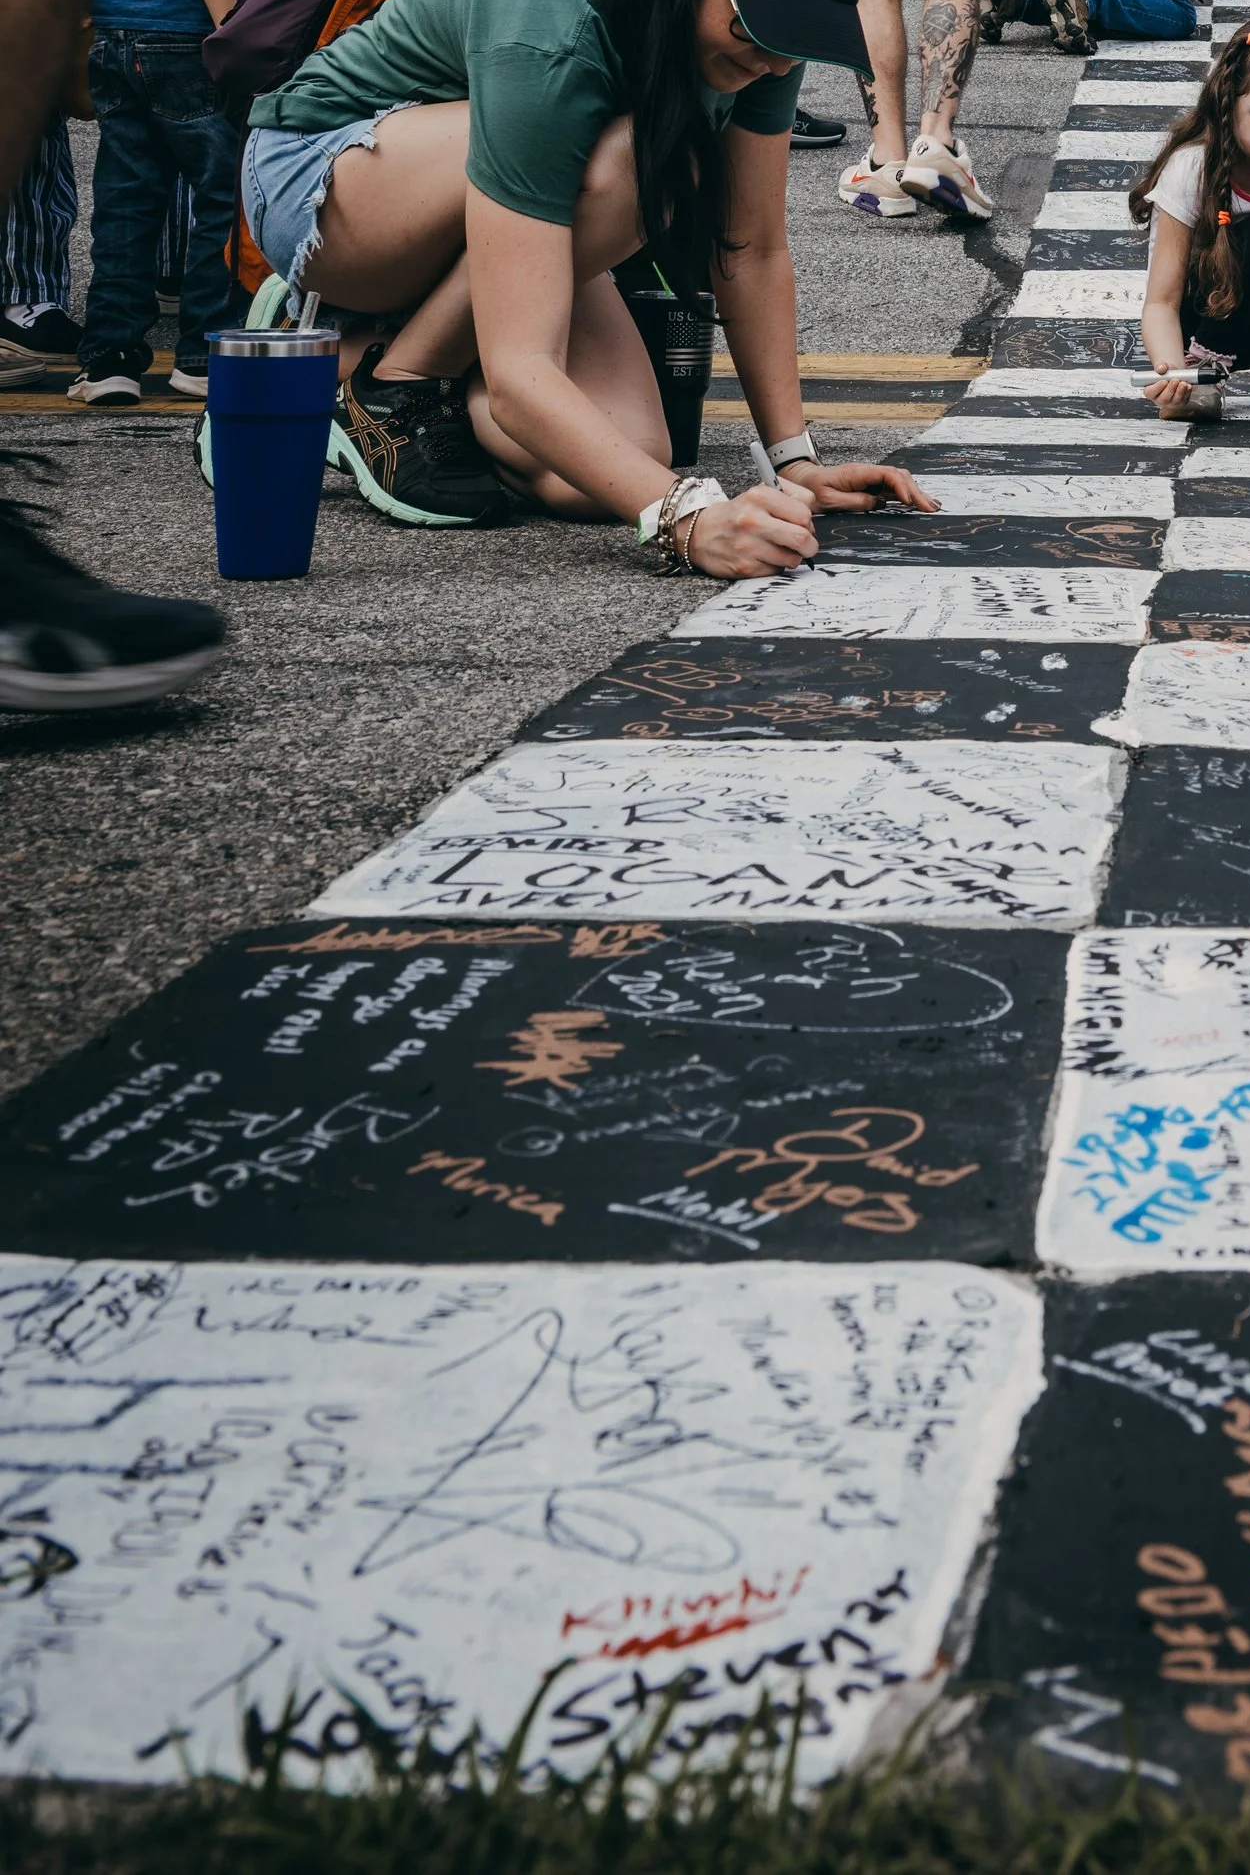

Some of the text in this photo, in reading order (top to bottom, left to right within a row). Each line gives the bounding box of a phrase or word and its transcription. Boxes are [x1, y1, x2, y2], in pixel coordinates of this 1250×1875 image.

[668, 311, 684, 321] US
[672, 366, 695, 377] EST
[429, 847, 901, 890] LOGAN
